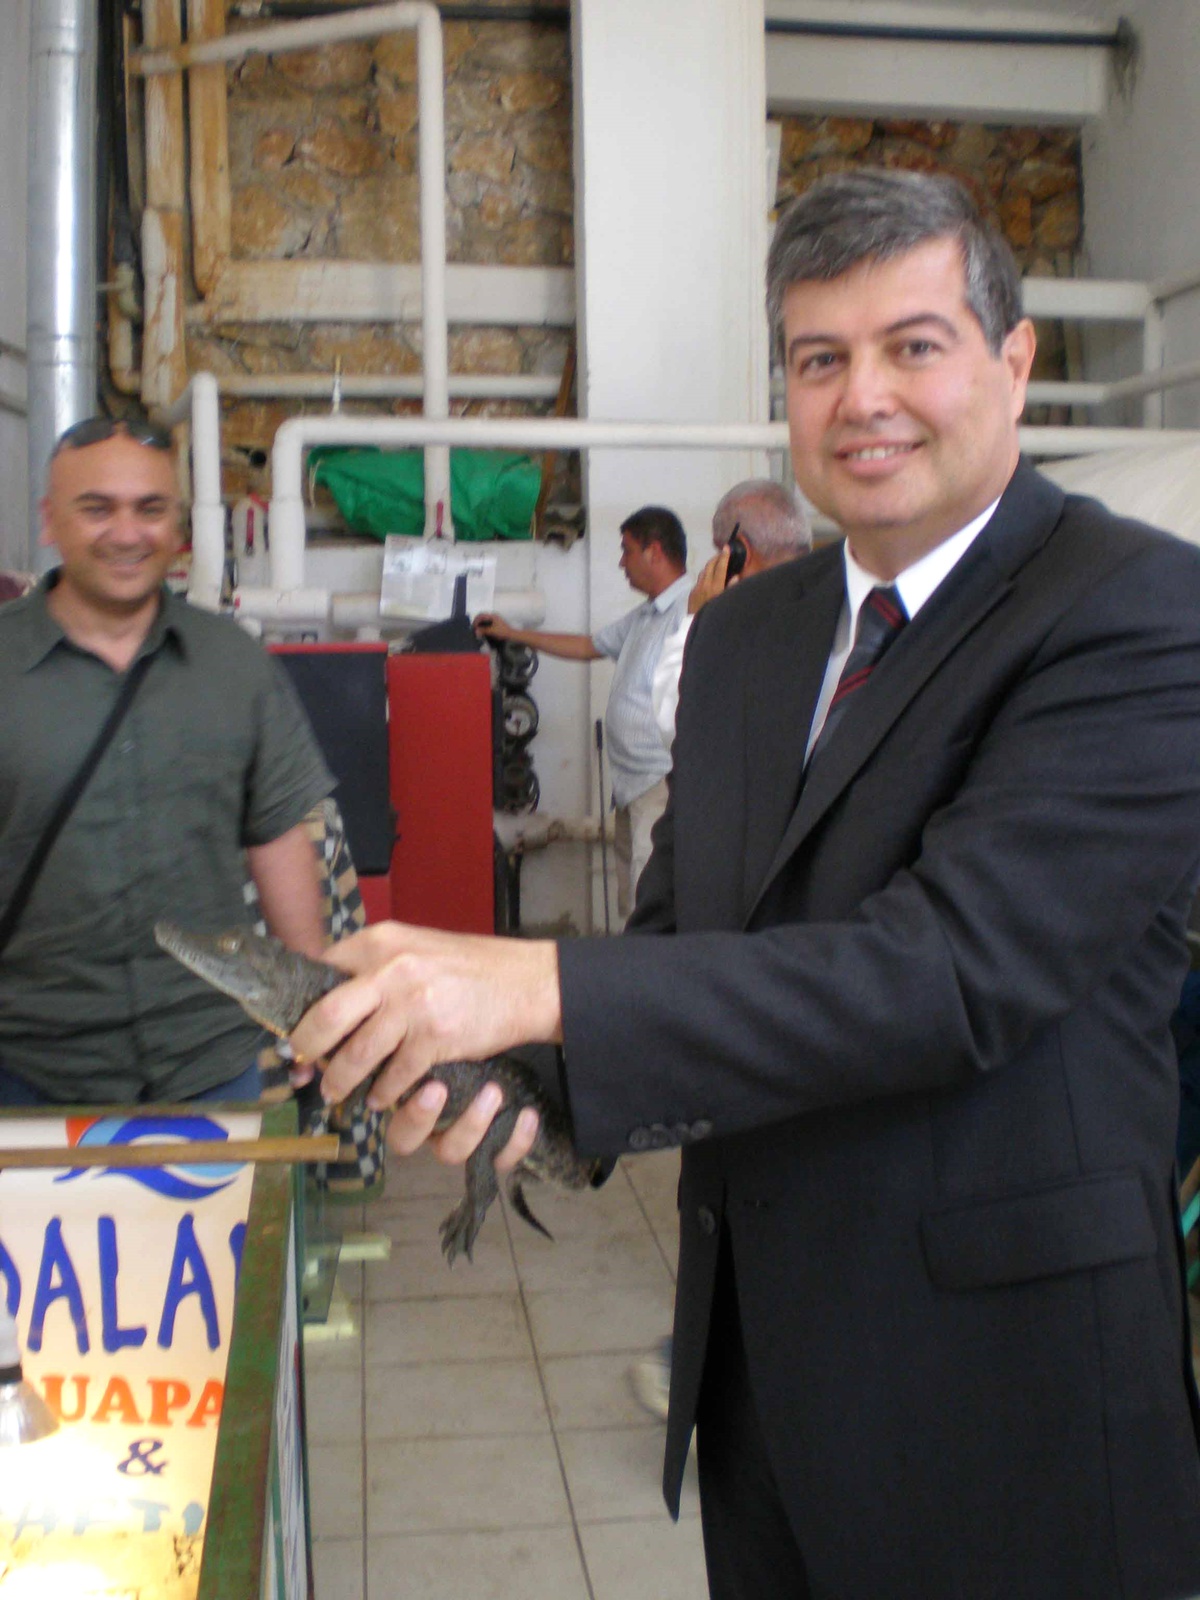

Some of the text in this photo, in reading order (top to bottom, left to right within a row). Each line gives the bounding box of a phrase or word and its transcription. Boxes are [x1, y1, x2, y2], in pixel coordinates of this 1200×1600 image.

[0, 1214, 248, 1356] ALA
[40, 1374, 225, 1428] UAPA
[116, 1437, 168, 1476] &
